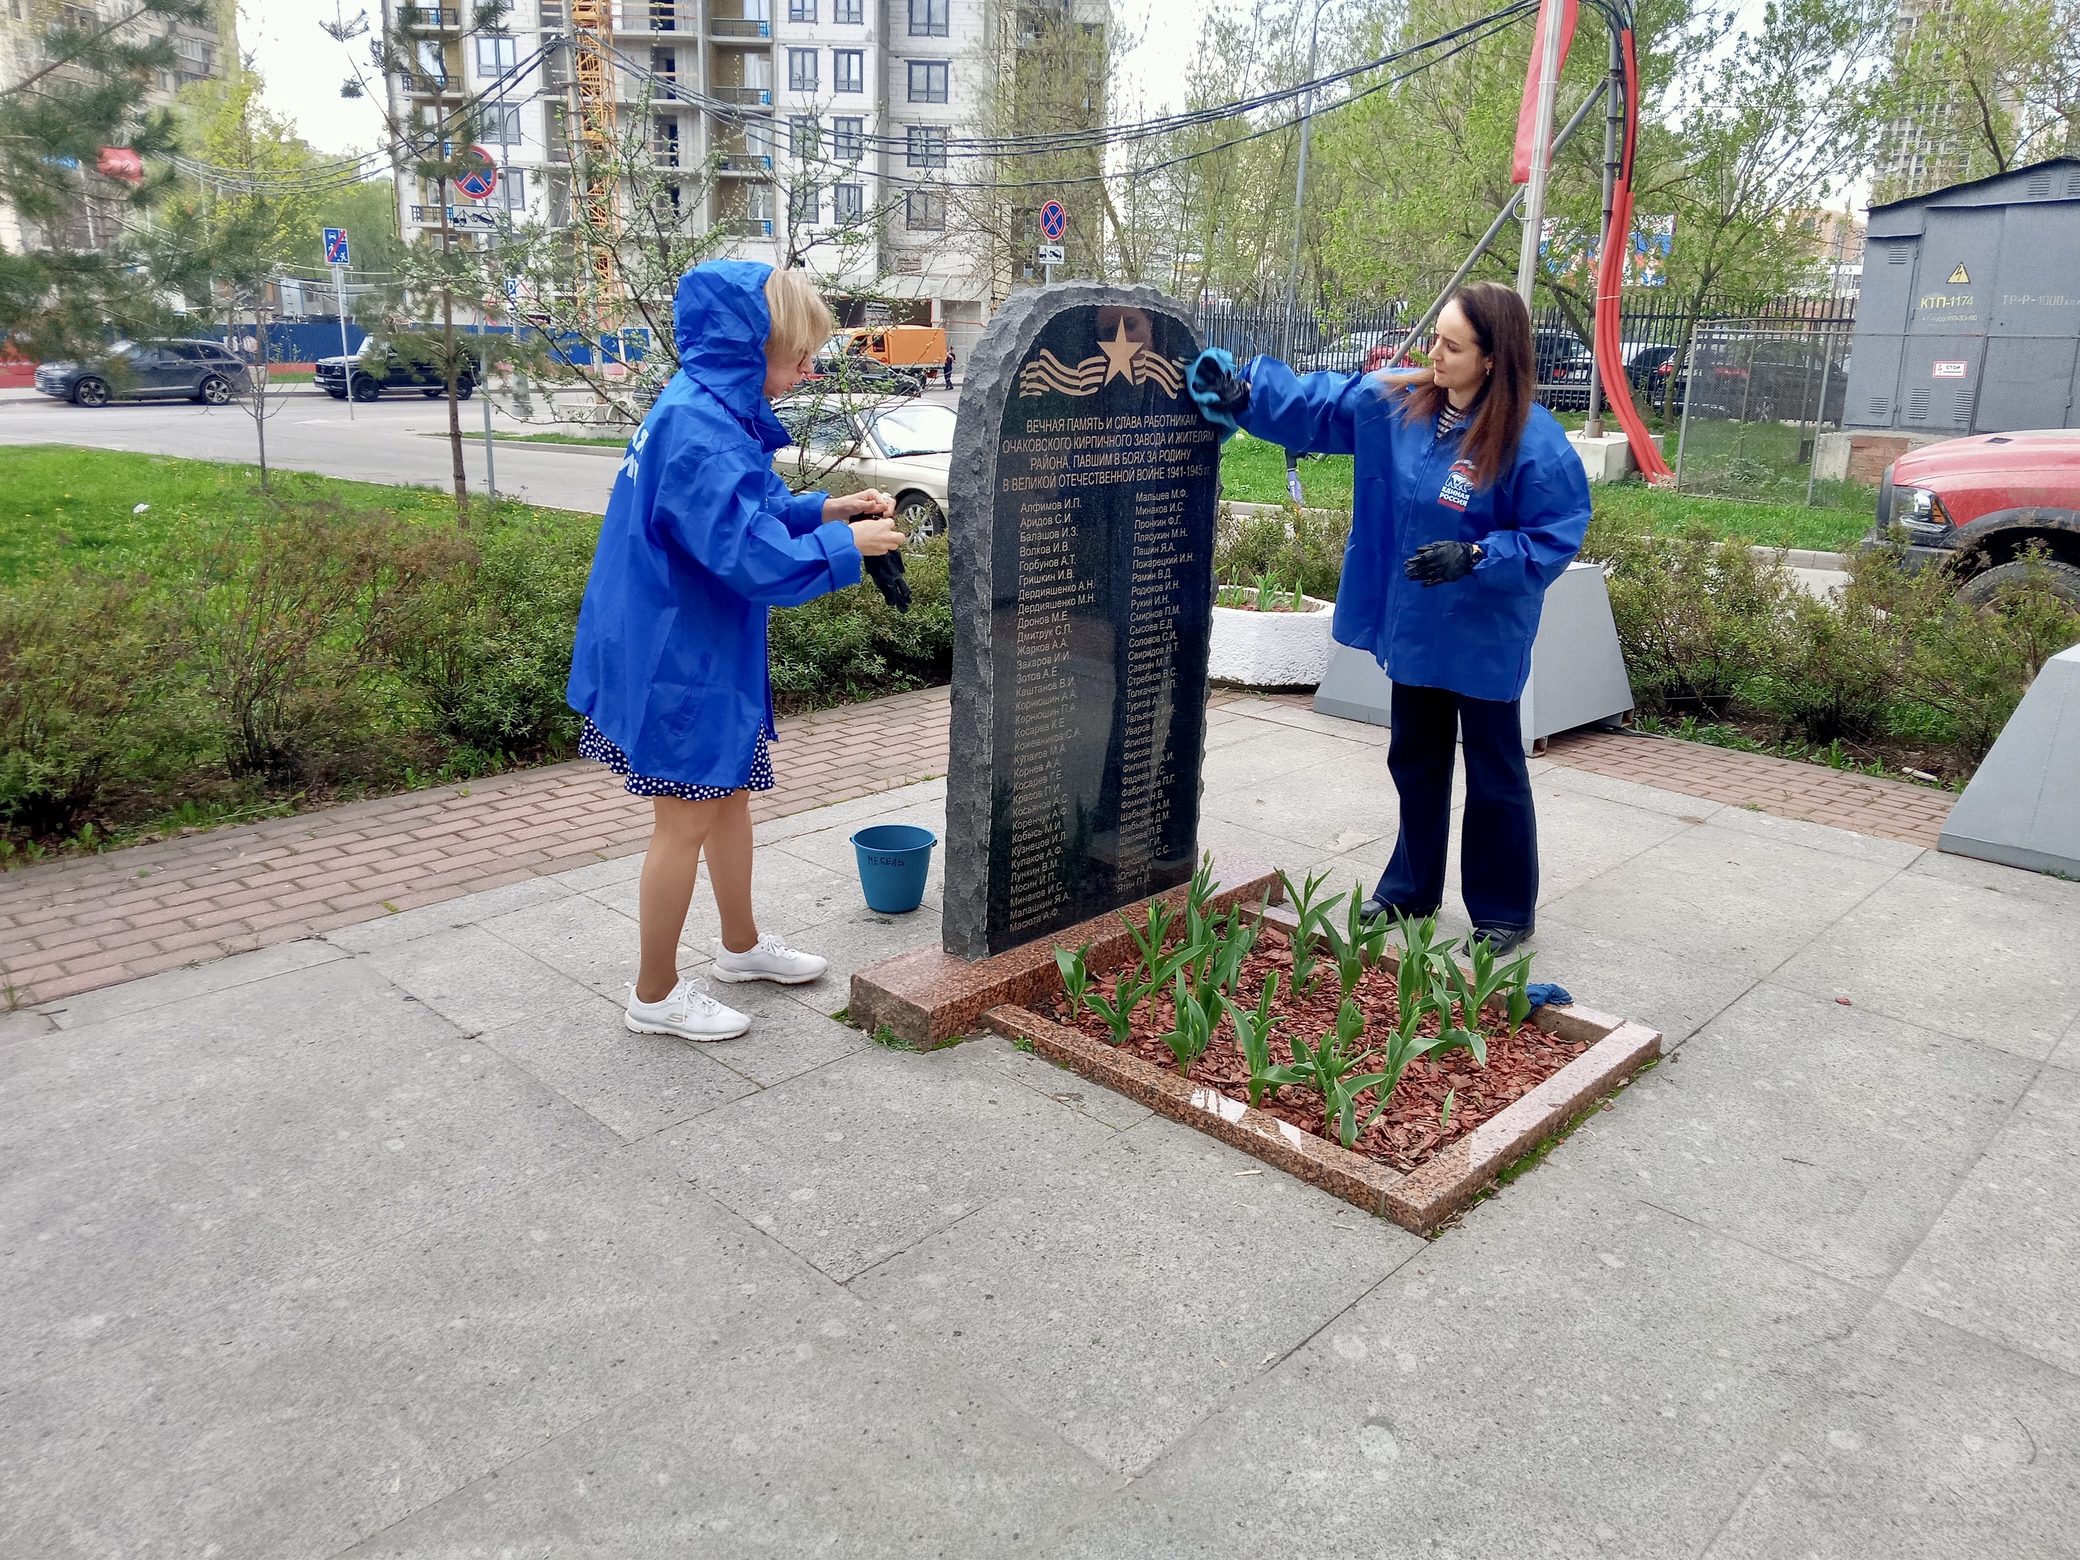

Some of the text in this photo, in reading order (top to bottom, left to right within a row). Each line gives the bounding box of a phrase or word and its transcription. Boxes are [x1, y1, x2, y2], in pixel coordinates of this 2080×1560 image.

[1921, 296, 1974, 308] КТП-1174
[1027, 414, 1197, 433] ВЕЧНАЯ ПАМЯТЬ И СЛАВА РАБОТНИКАМ
[1003, 430, 1214, 453] ОЧАКОВСКОГО КИРПИЧНОГО ЗАВОДА И ЖИТЕЛЯМ
[1030, 449, 1191, 470] РАЙОНА, ПАВШИМ В БОЯХ ЗА РОДИНУ
[1003, 479, 1010, 492] В
[1012, 473, 1056, 491] ВЕЛИКОЙ
[1058, 467, 1135, 488] ОТЕЧЕСТВЕННОЙ
[1137, 466, 1165, 481] ВОЙНЕ
[1167, 465, 1203, 479] 1941-1945
[1136, 489, 1188, 502] Мальцев М.Ф.
[1439, 492, 1468, 507] РОССИЯ
[1441, 486, 1470, 500] ЕДИНАЯ
[1021, 498, 1081, 514] Алфимов И.П.
[1135, 502, 1185, 516] Минаков И.С.
[1020, 513, 1073, 529] Аридов С.И.
[1135, 519, 1166, 530] Пронкин
[1020, 526, 1078, 542] Балашов И.З.
[1134, 528, 1188, 543] Плясухин М.Н.
[1020, 542, 1070, 556] Волков И.В.
[1133, 542, 1176, 556] Пашин Я.А.
[1020, 554, 1076, 572] Горбунов А.Т.
[1132, 553, 1194, 569] Пожарецкий И.Н.
[1019, 569, 1075, 587] Гришкин И.В.
[1158, 568, 1173, 579] В.Д.
[1018, 580, 1095, 602] Дердияшенко А.Н.
[1165, 580, 1180, 591] И.Н.
[1018, 593, 1096, 616] Дердияшенко М.Н.
[1155, 595, 1170, 605] И.Н.
[1017, 611, 1069, 630] Дронов М.Е.
[1130, 605, 1181, 622] Смирнов П.М.
[1017, 624, 1072, 644] Дмитрук С.П.
[1129, 623, 1158, 635] Сысоев
[1162, 631, 1177, 641] С.И.
[1017, 638, 1068, 656] Жарков А.А.
[1128, 642, 1179, 661] Свиридов Н.Т.
[1017, 651, 1071, 670] Захаров И.И.
[1017, 666, 1059, 684] Зотов А.Е.
[1127, 667, 1177, 686] Стребков В.С.
[1016, 677, 1076, 697] Каштанов В.И.
[1015, 690, 1078, 711] Корнюшин А.А.
[1015, 708, 1059, 724] Корнюшин
[1014, 724, 1049, 738] Косарев
[1066, 727, 1083, 739] С.А.
[1050, 744, 1067, 755] М.А.
[1014, 764, 1043, 778] Корнев
[1122, 772, 1150, 785] Фадеев
[1013, 775, 1048, 792] Косарев
[1150, 790, 1164, 800] Н.В.
[1012, 807, 1069, 831] Коренчук А.Ф.
[1012, 821, 1063, 844] Кобысь М.И.
[1011, 839, 1050, 857] Кузнецов
[1011, 846, 1063, 870] Кулаков А.Ф.
[1042, 859, 1059, 872] В.М.
[1040, 872, 1056, 885] И.П.
[1010, 882, 1065, 907] Минаков И.С.
[1054, 892, 1070, 905] Я.А.
[1043, 908, 1060, 920] А.Ф.
